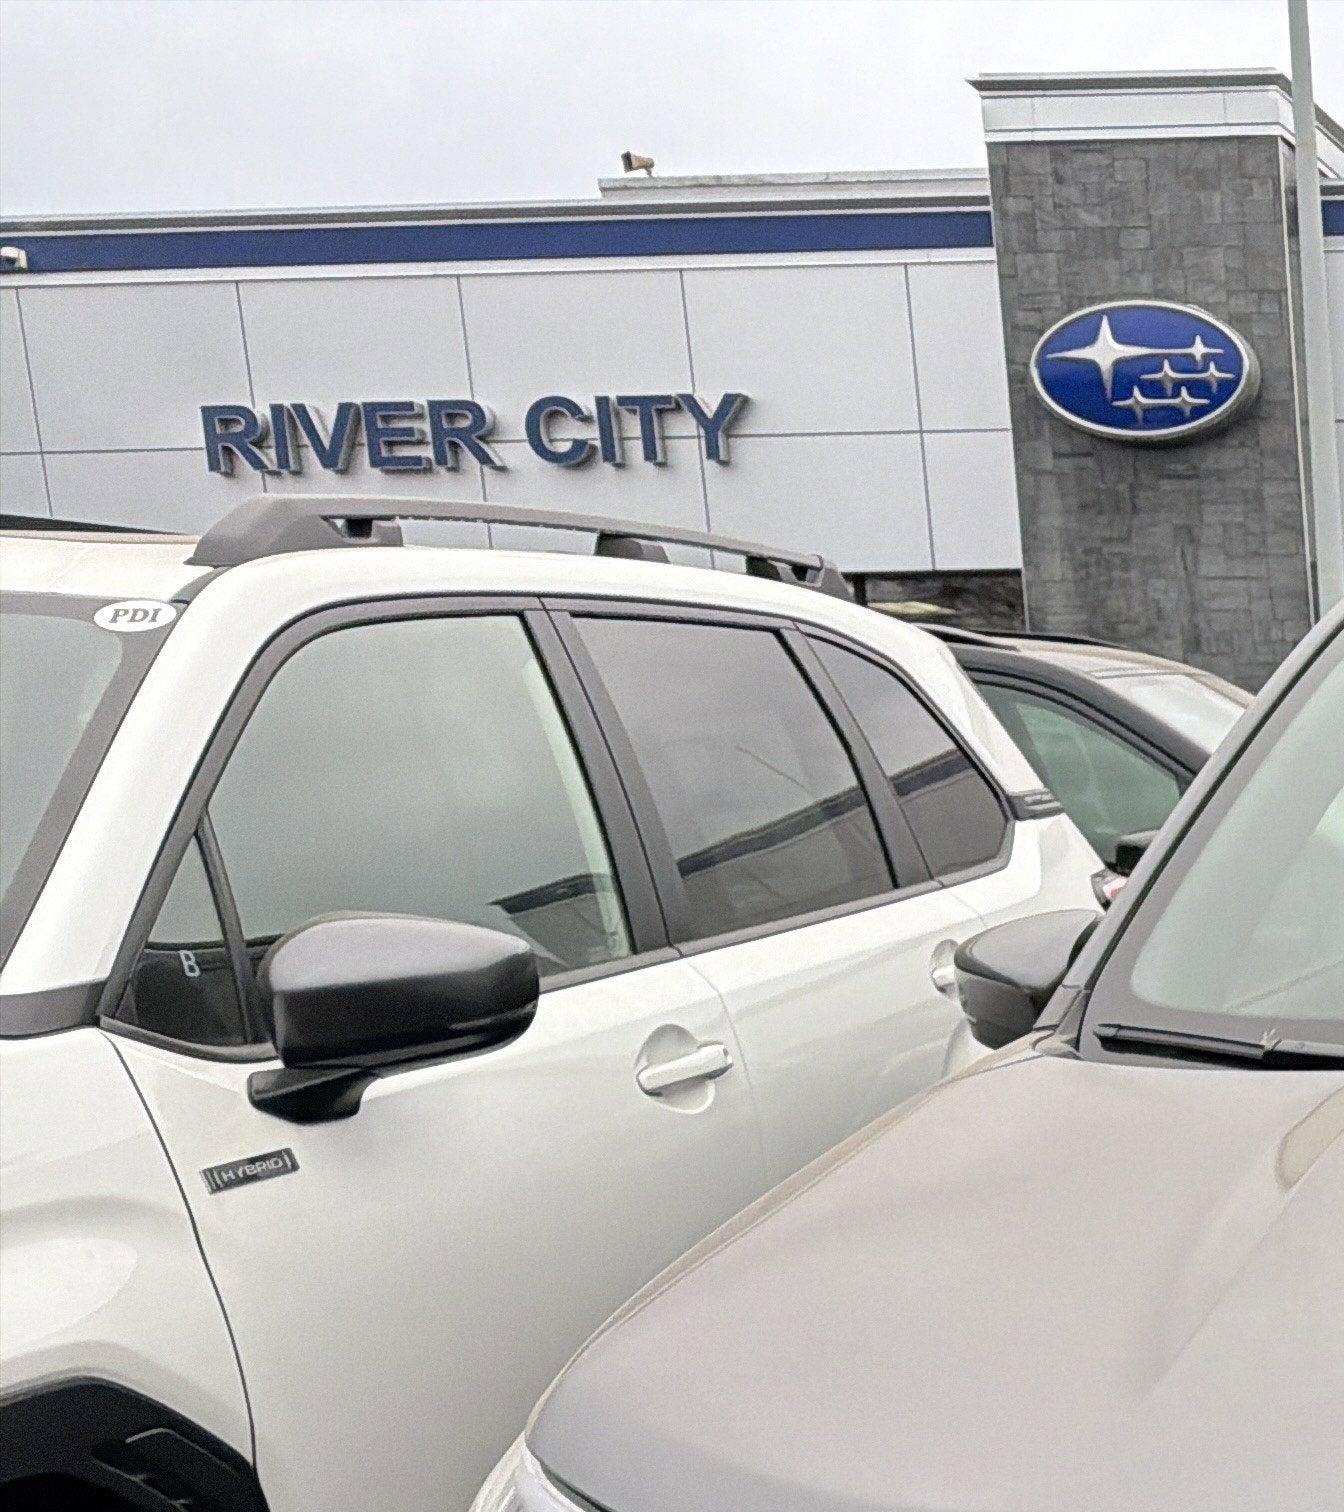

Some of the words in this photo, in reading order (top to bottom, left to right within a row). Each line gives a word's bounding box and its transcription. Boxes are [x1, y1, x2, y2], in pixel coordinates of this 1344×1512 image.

[200, 399, 499, 473] RIVER
[524, 393, 746, 467] CITY
[108, 607, 162, 623] PDI
[219, 1157, 284, 1183] HYBRID
